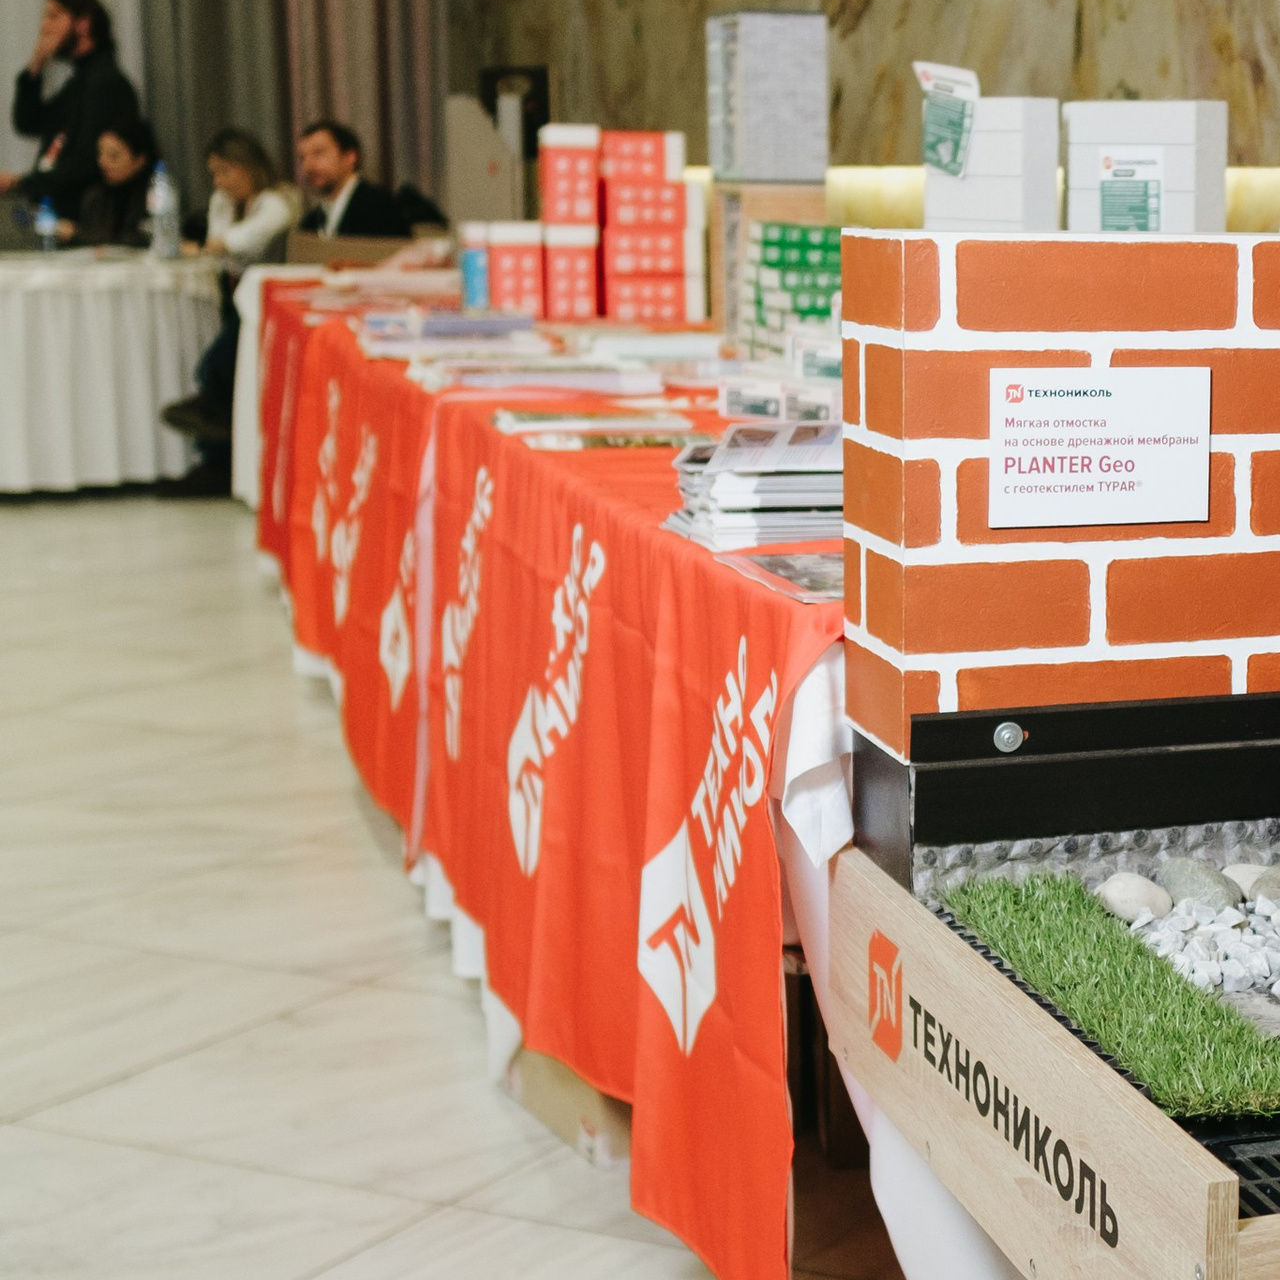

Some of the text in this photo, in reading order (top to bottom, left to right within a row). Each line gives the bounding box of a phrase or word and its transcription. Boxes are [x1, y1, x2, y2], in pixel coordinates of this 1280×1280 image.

[1028, 389, 1112, 398] ТЕХНОНИКОЛЬ
[1005, 417, 1107, 428] Мягкая отмостка
[1004, 434, 1199, 449] на основе дренажной мембраны
[1004, 455, 1135, 474] PLANTER Geo
[1004, 485, 1010, 494] с
[1013, 484, 1094, 494] геотекстилем
[909, 994, 1119, 1249] ТЕХНОНИКОЛЬ
